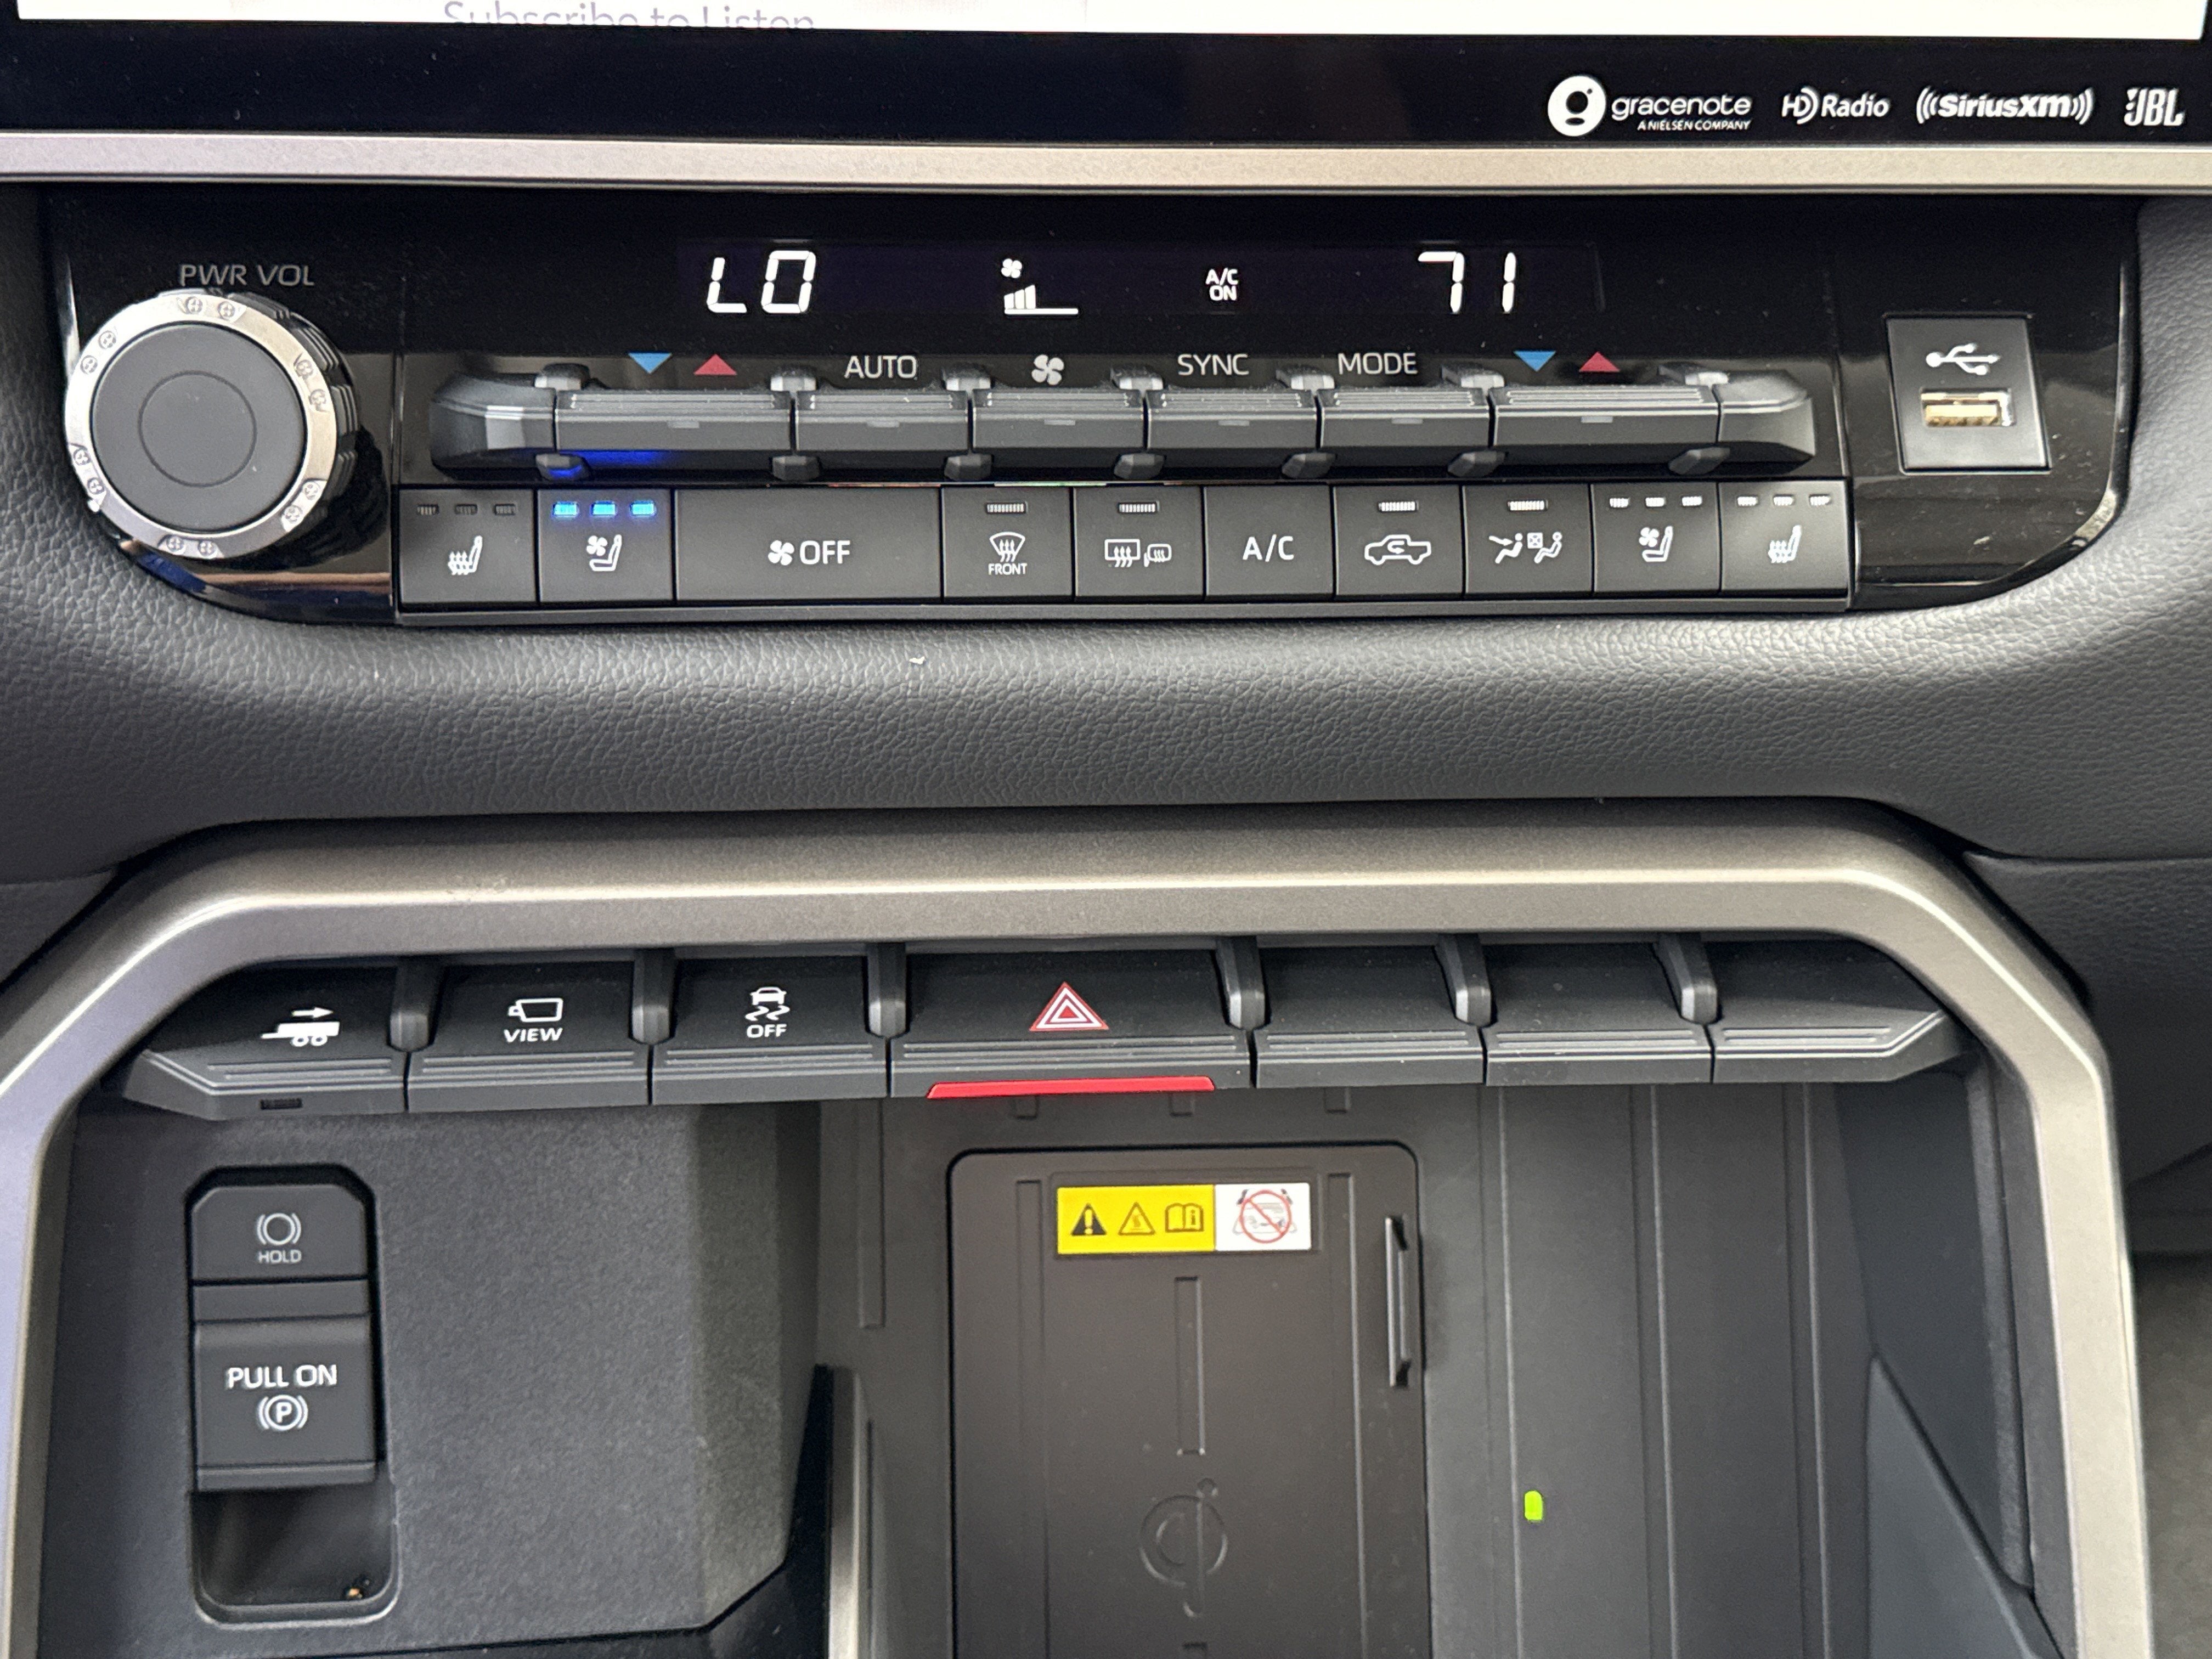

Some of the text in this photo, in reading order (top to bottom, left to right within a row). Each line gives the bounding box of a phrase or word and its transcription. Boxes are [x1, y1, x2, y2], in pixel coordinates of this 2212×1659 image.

[1611, 94, 1752, 121] gracenote
[1781, 89, 1891, 121] HD Radio
[2124, 88, 2187, 126] JBL
[1637, 119, 1752, 131] A NIELSEN COMPANY
[179, 264, 314, 286] PWR VOL
[707, 250, 816, 313] LO
[1205, 268, 1239, 285] A/C
[1418, 251, 1516, 313] 71
[1209, 285, 1237, 301] ON
[844, 355, 917, 379] AUTO
[1177, 353, 1249, 376] SYNC
[1338, 352, 1418, 375] MODE
[799, 540, 851, 565] OFF
[1242, 534, 1295, 562] A/C
[988, 563, 1028, 575] FRONT
[504, 1028, 563, 1042] VIEW
[746, 1024, 787, 1039] OFF
[258, 1249, 302, 1263] HOLD
[227, 1364, 338, 1389] PULL ON
